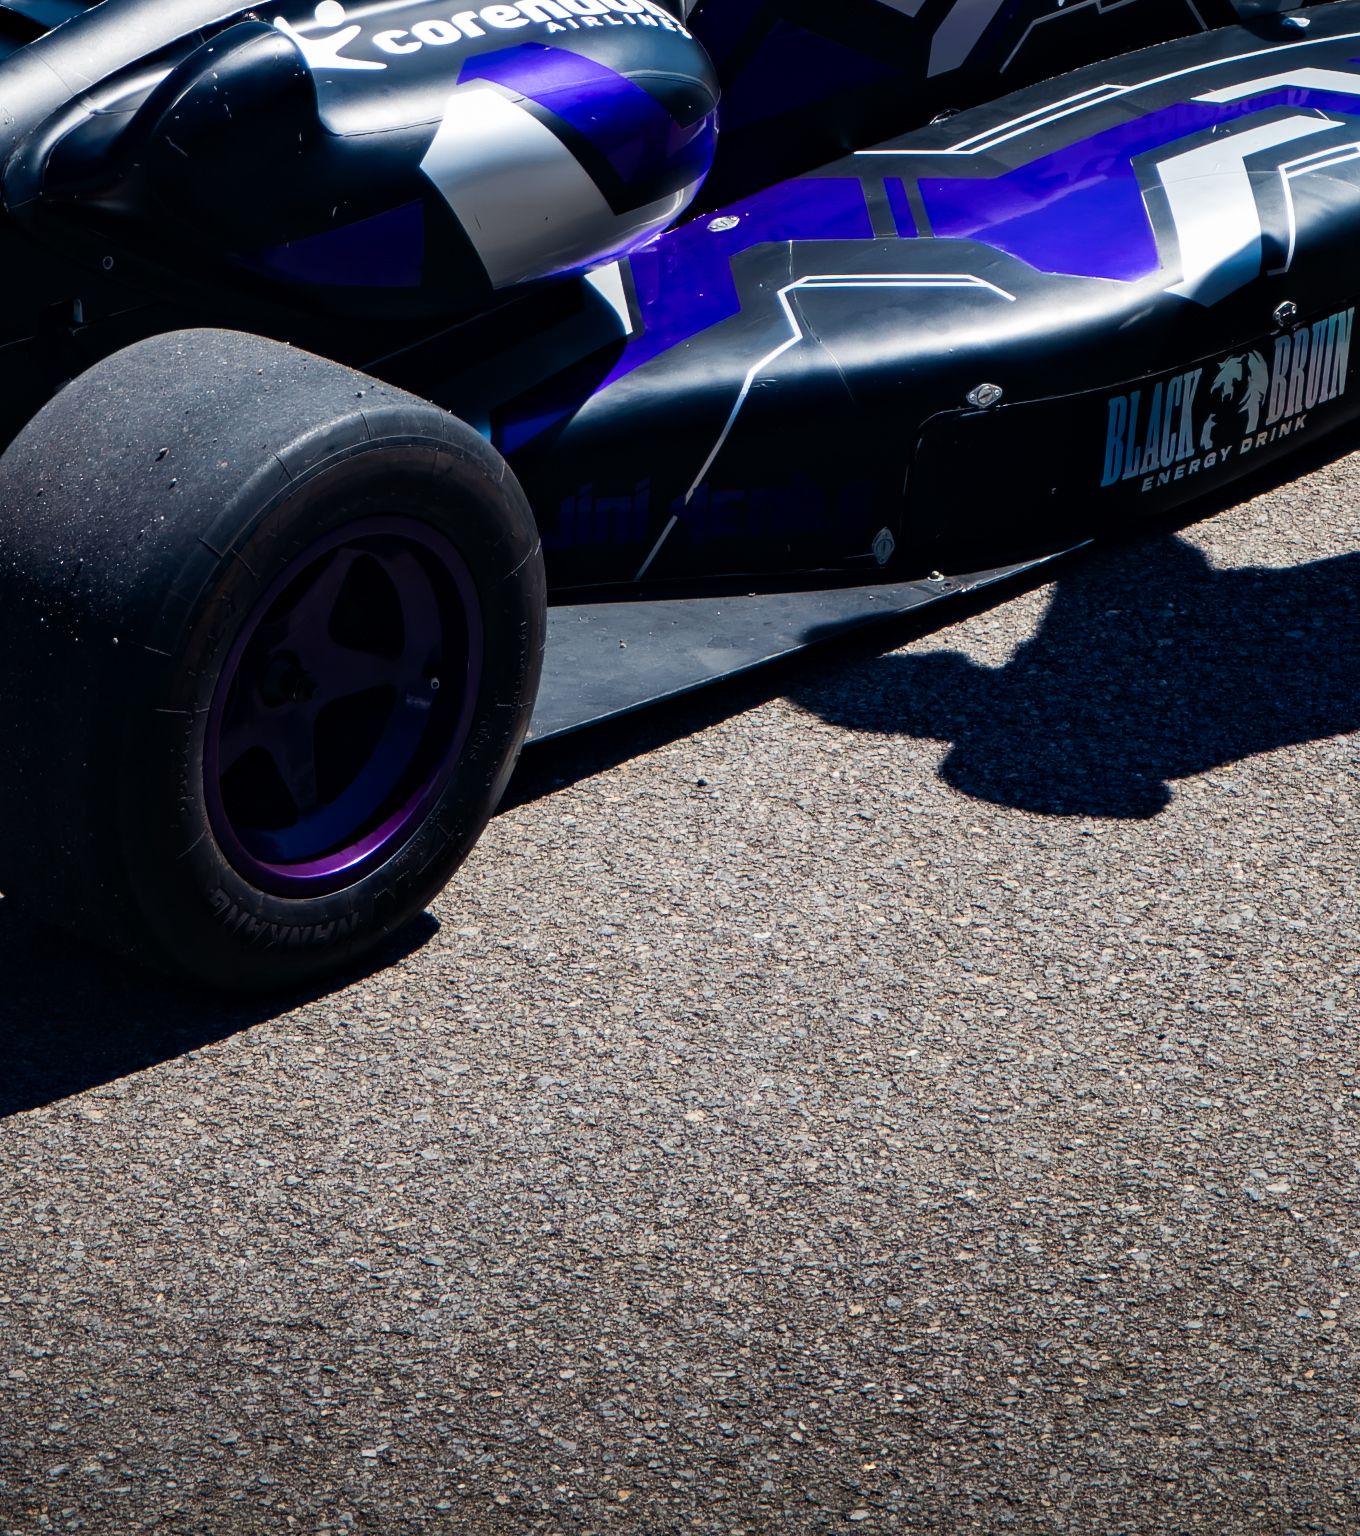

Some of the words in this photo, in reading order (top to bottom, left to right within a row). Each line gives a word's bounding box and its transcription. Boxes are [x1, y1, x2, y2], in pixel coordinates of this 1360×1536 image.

[547, 13, 693, 40] AIRLINES
[1099, 366, 1205, 489] BLACK
[1264, 306, 1356, 427] BRUIN
[1140, 443, 1234, 494] ENERGY
[1239, 414, 1309, 456] DRINK
